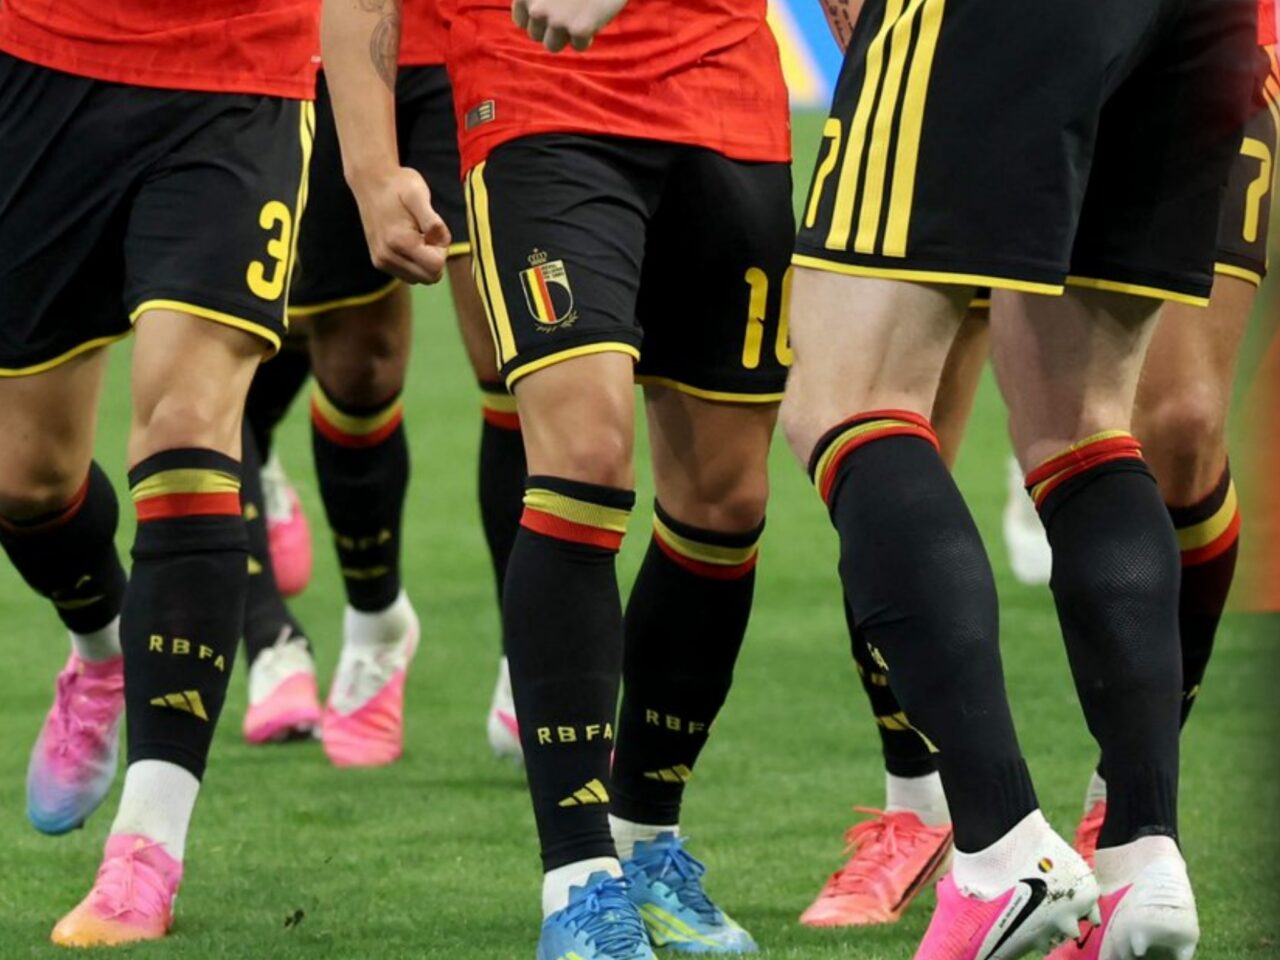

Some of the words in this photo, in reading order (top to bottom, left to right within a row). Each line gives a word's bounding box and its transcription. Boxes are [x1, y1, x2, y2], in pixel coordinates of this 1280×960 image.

[805, 118, 841, 228] 7
[1240, 136, 1272, 242] 7
[246, 200, 292, 301] 3
[149, 634, 225, 672] RBFA
[537, 722, 613, 744] RBFA
